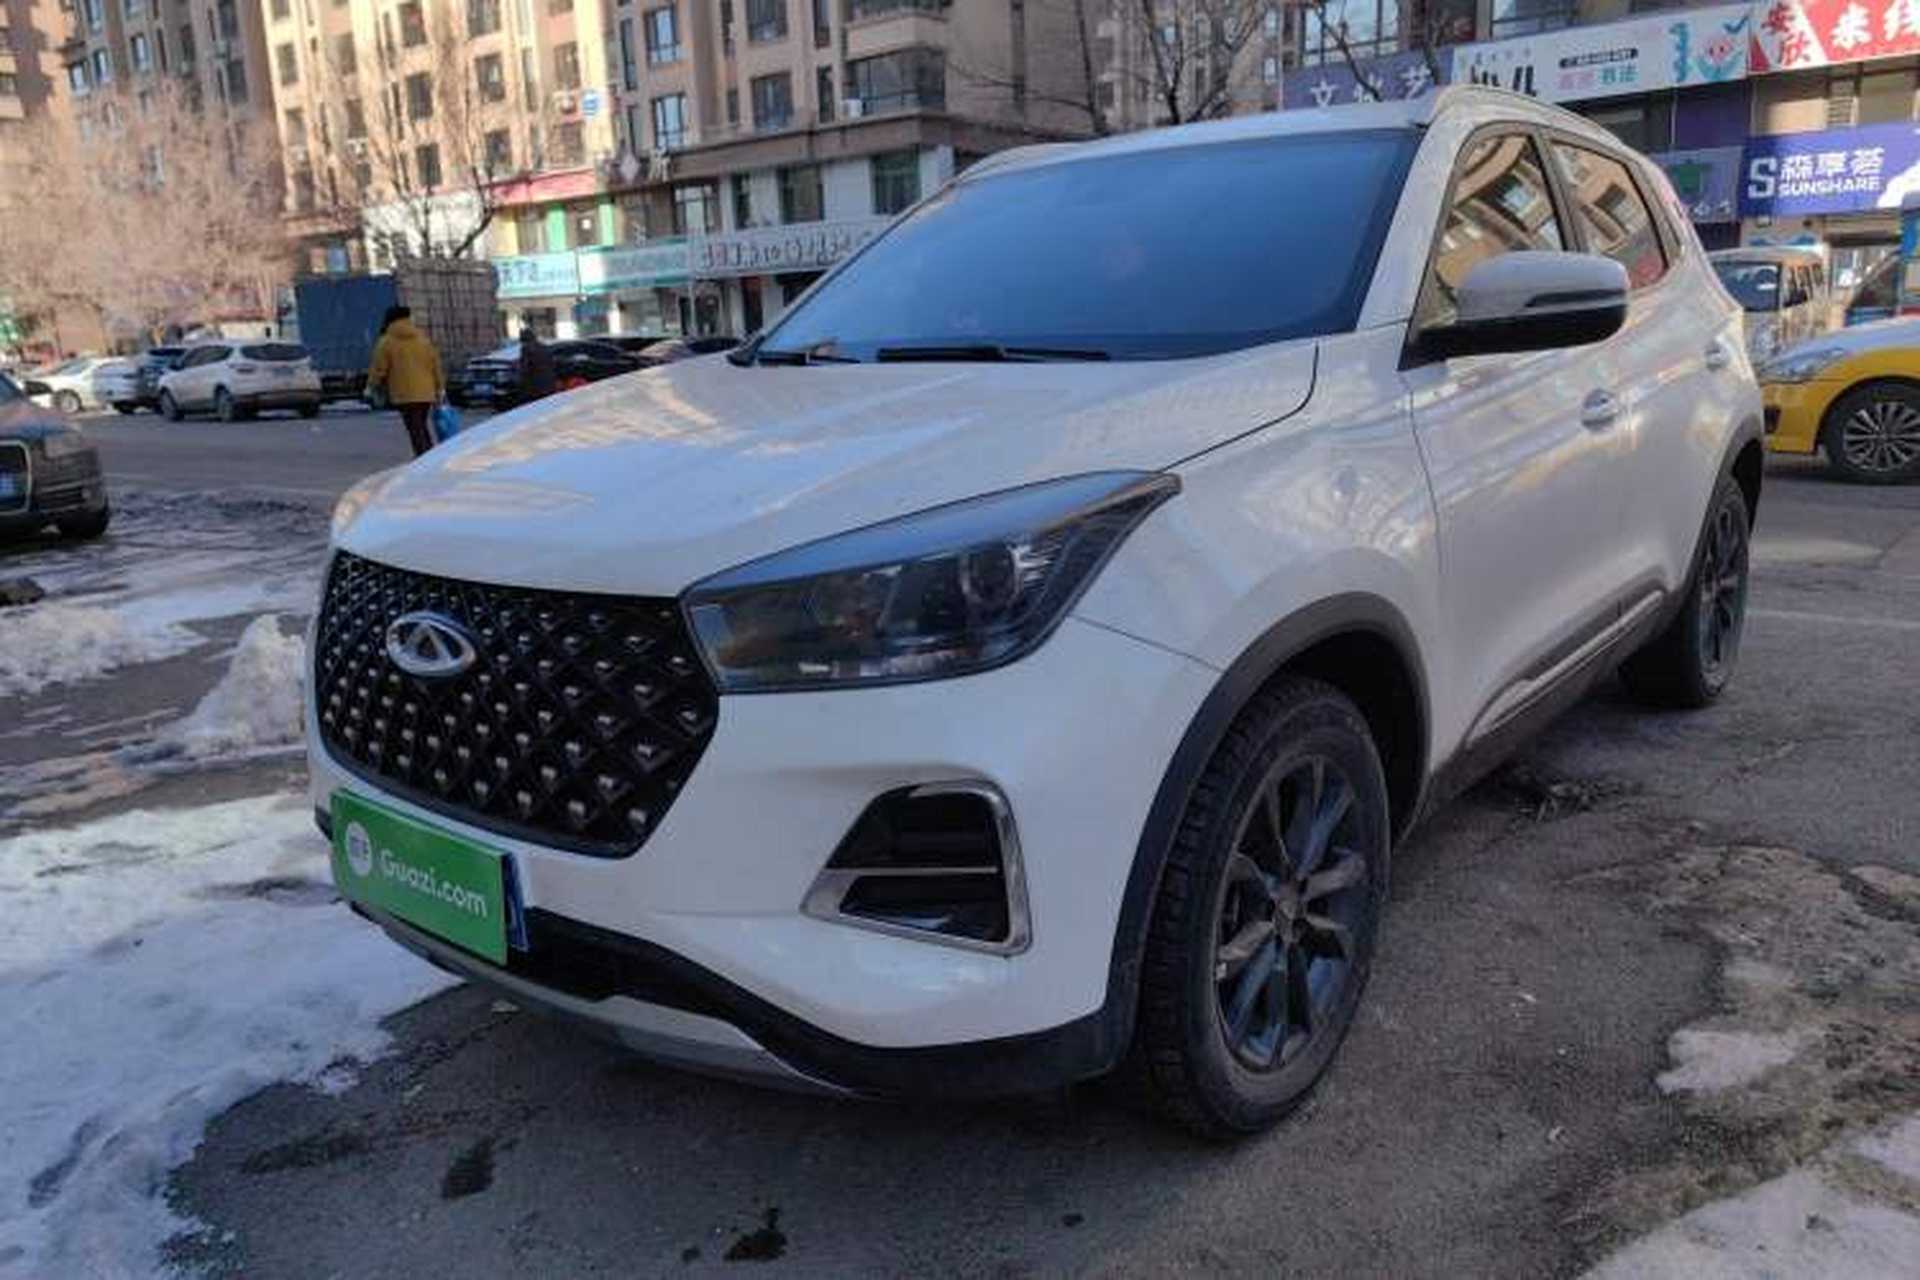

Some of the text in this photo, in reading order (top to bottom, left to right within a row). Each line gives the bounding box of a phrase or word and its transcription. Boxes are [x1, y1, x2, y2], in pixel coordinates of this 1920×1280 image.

[1748, 158, 1777, 198] S
[1778, 175, 1882, 197] SUNSHARE
[380, 849, 488, 917] Guazi.com
